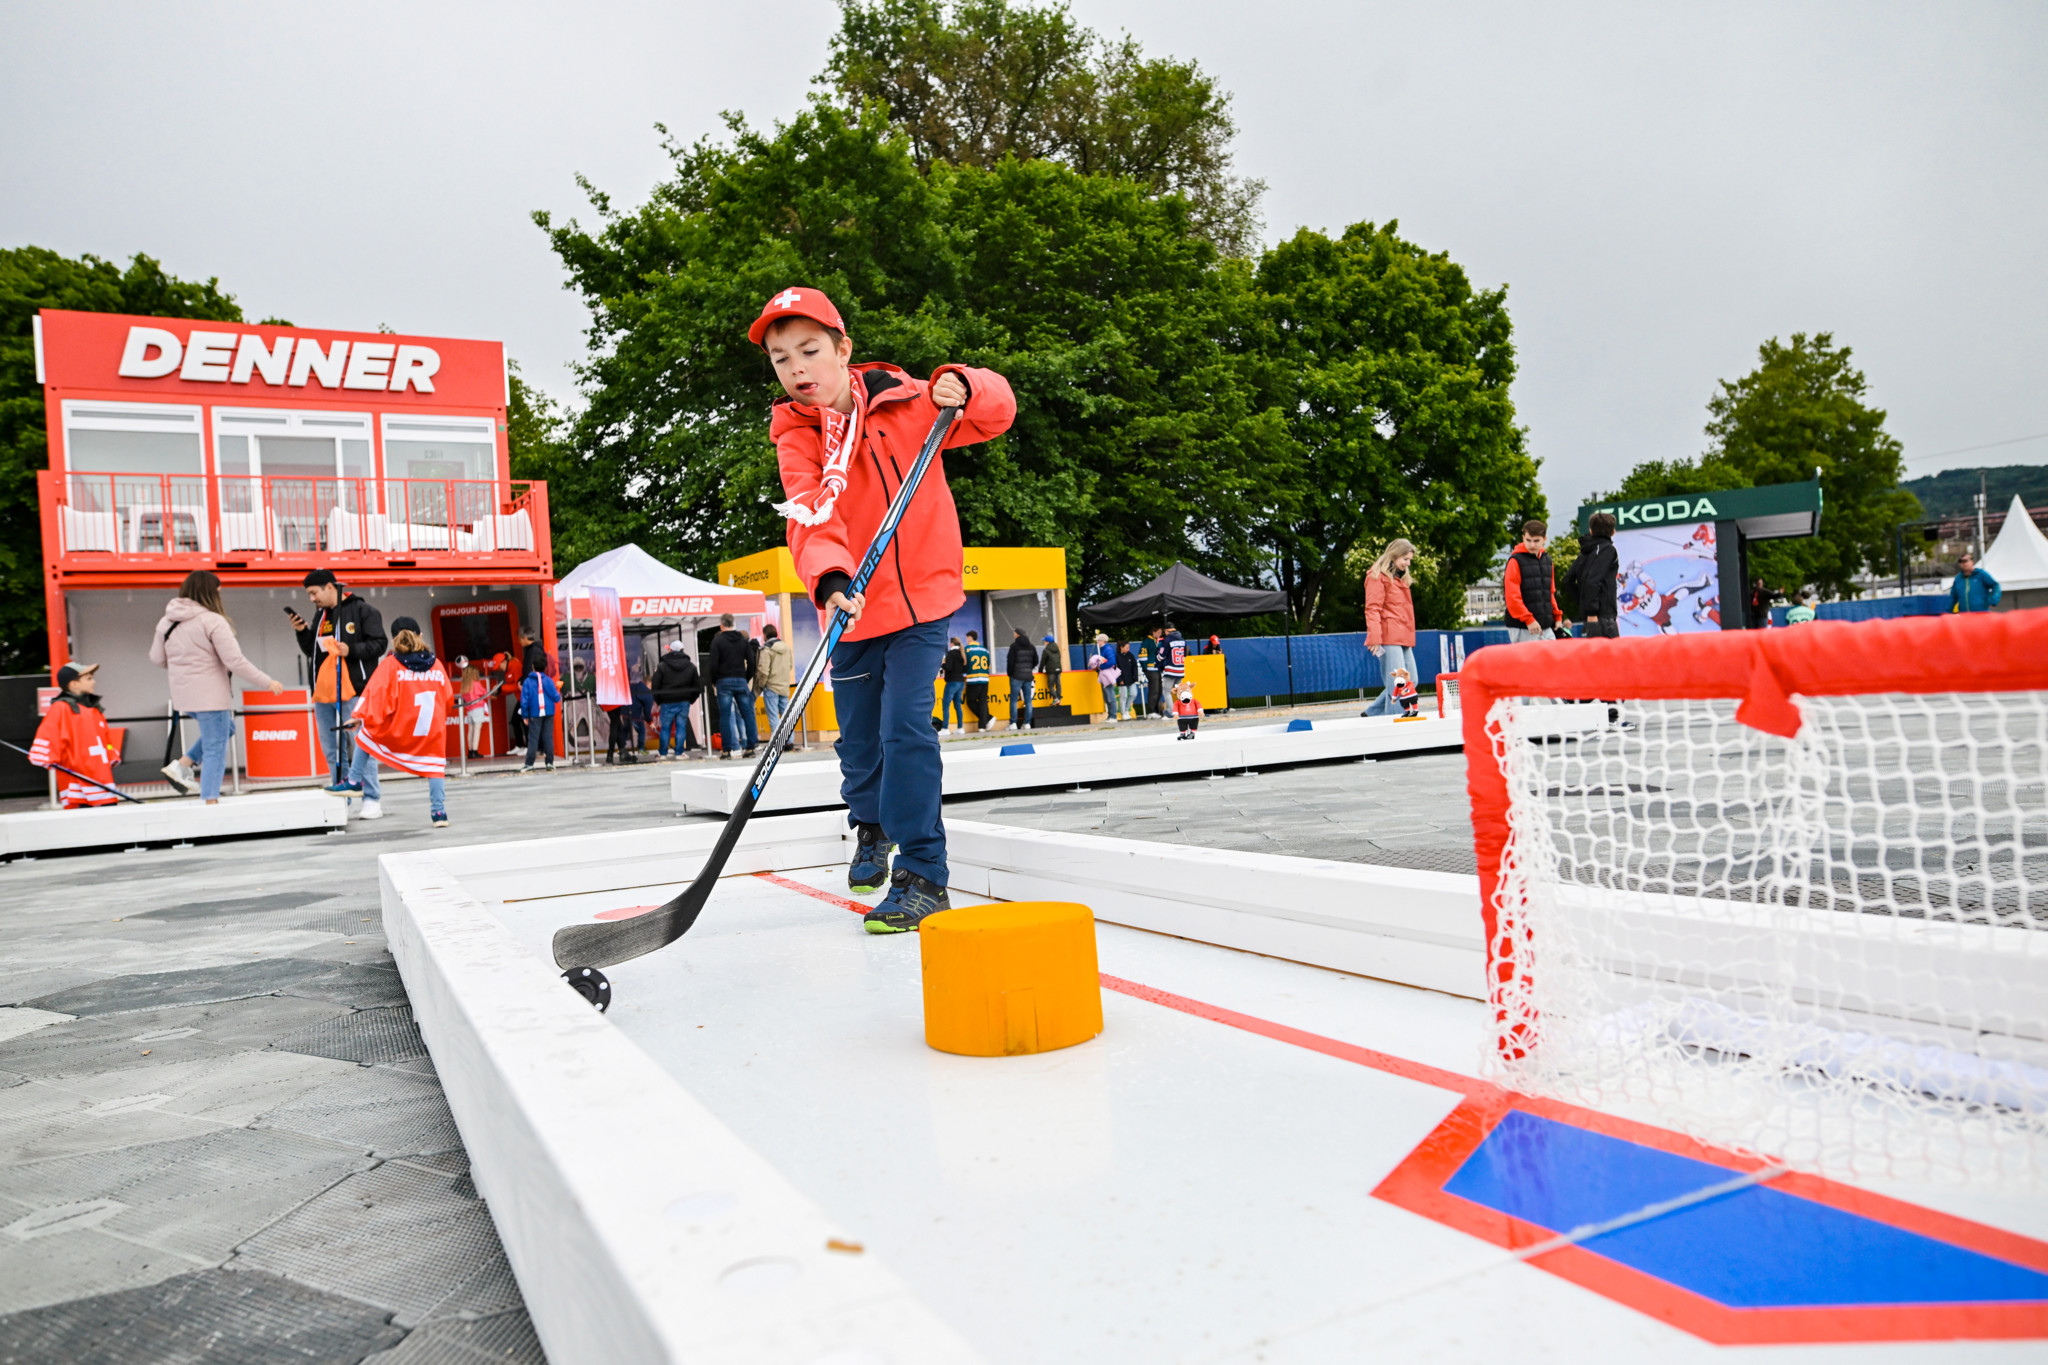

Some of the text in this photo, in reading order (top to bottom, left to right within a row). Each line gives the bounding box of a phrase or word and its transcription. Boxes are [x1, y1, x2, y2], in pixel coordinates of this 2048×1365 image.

[118, 326, 441, 393] DENNER
[733, 569, 769, 586] PostFinance
[440, 603, 508, 616] BONJOUR ZÜRICH
[630, 597, 714, 615] DENNER
[970, 655, 989, 670] 26
[412, 690, 437, 737] 1
[252, 730, 298, 741] DENNER
